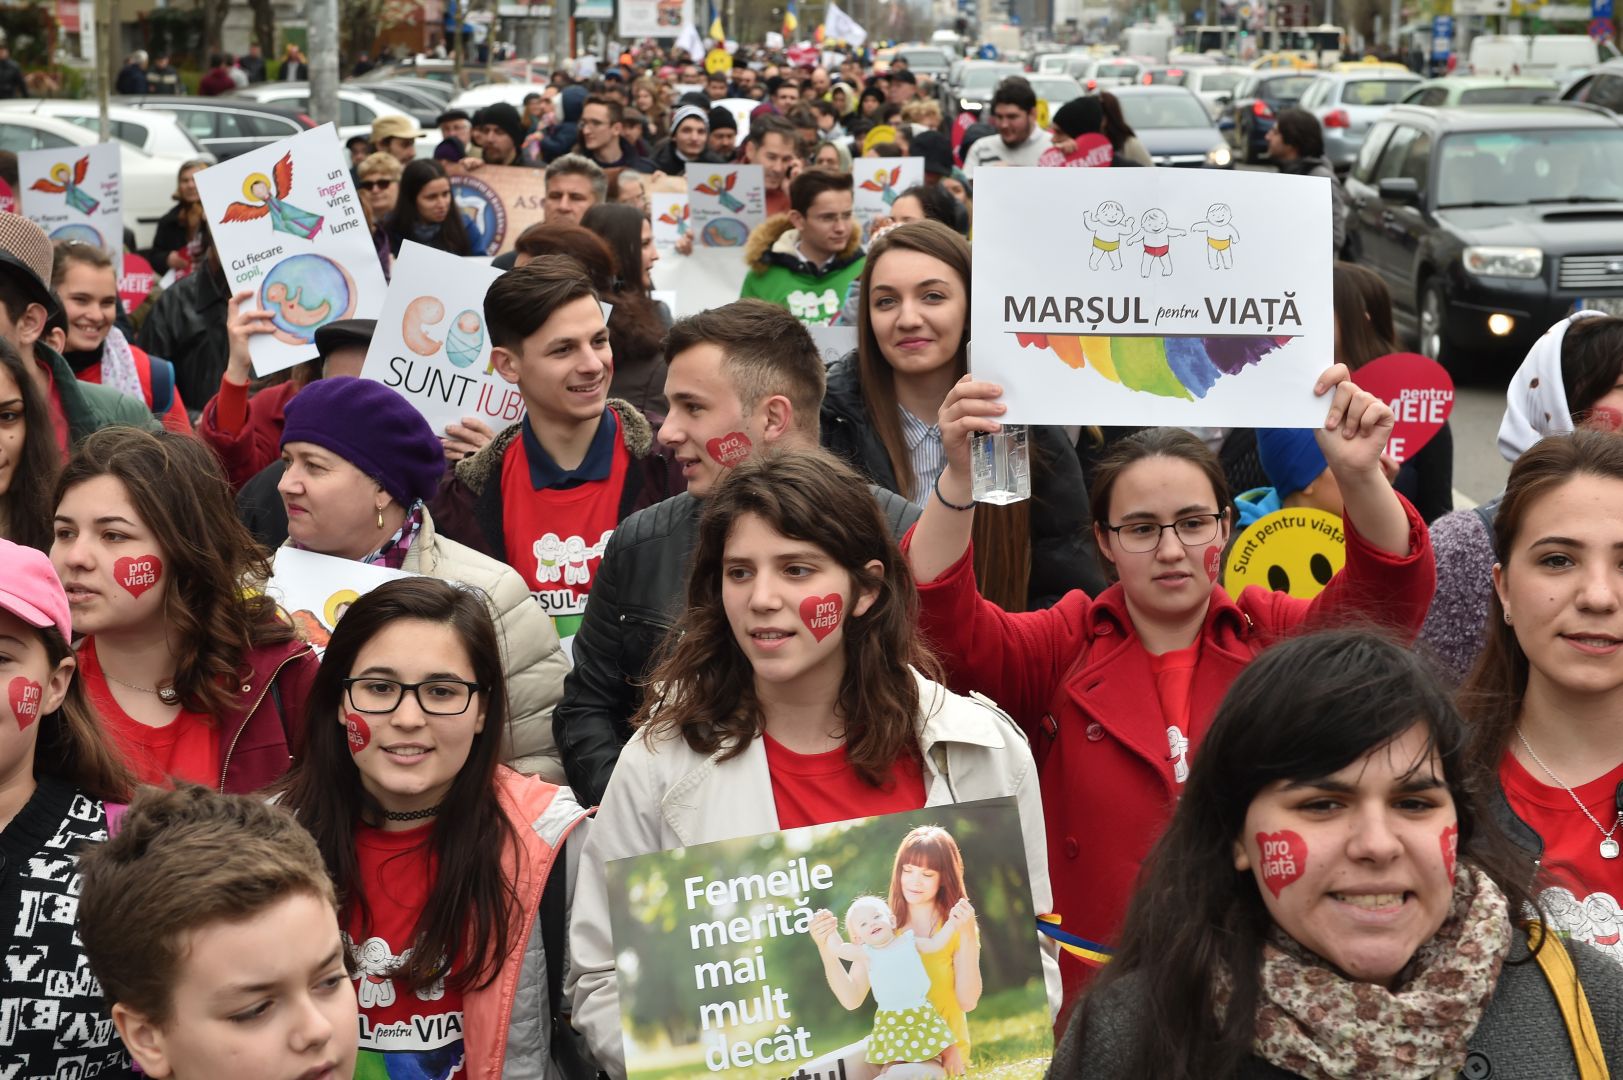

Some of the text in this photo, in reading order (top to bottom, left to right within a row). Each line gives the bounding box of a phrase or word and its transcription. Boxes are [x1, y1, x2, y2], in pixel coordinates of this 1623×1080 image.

[327, 168, 343, 181] un
[317, 180, 346, 202] inger
[326, 193, 351, 208] vine
[343, 206, 356, 217] in
[329, 217, 359, 235] lume
[231, 245, 284, 272] Cu fiecare
[235, 265, 264, 283] copil,
[1003, 291, 1303, 332] MARȘUL pentru VIAȚĂ
[383, 356, 478, 407] SUNT
[1400, 388, 1454, 401] pentru
[1233, 538, 1259, 575] Sunt
[1255, 514, 1307, 545] pentru
[124, 570, 155, 587] viață
[128, 561, 152, 576] pro
[810, 610, 838, 629] viață
[816, 601, 836, 618] pro
[23, 686, 39, 702] pro
[1263, 840, 1289, 861] pro
[684, 857, 834, 910] Femeile
[689, 896, 815, 950] merită
[694, 946, 767, 990] mai
[700, 984, 792, 1031] mult
[375, 1024, 413, 1044] pentru
[414, 1014, 464, 1043] VIA
[705, 1024, 814, 1073] decât
